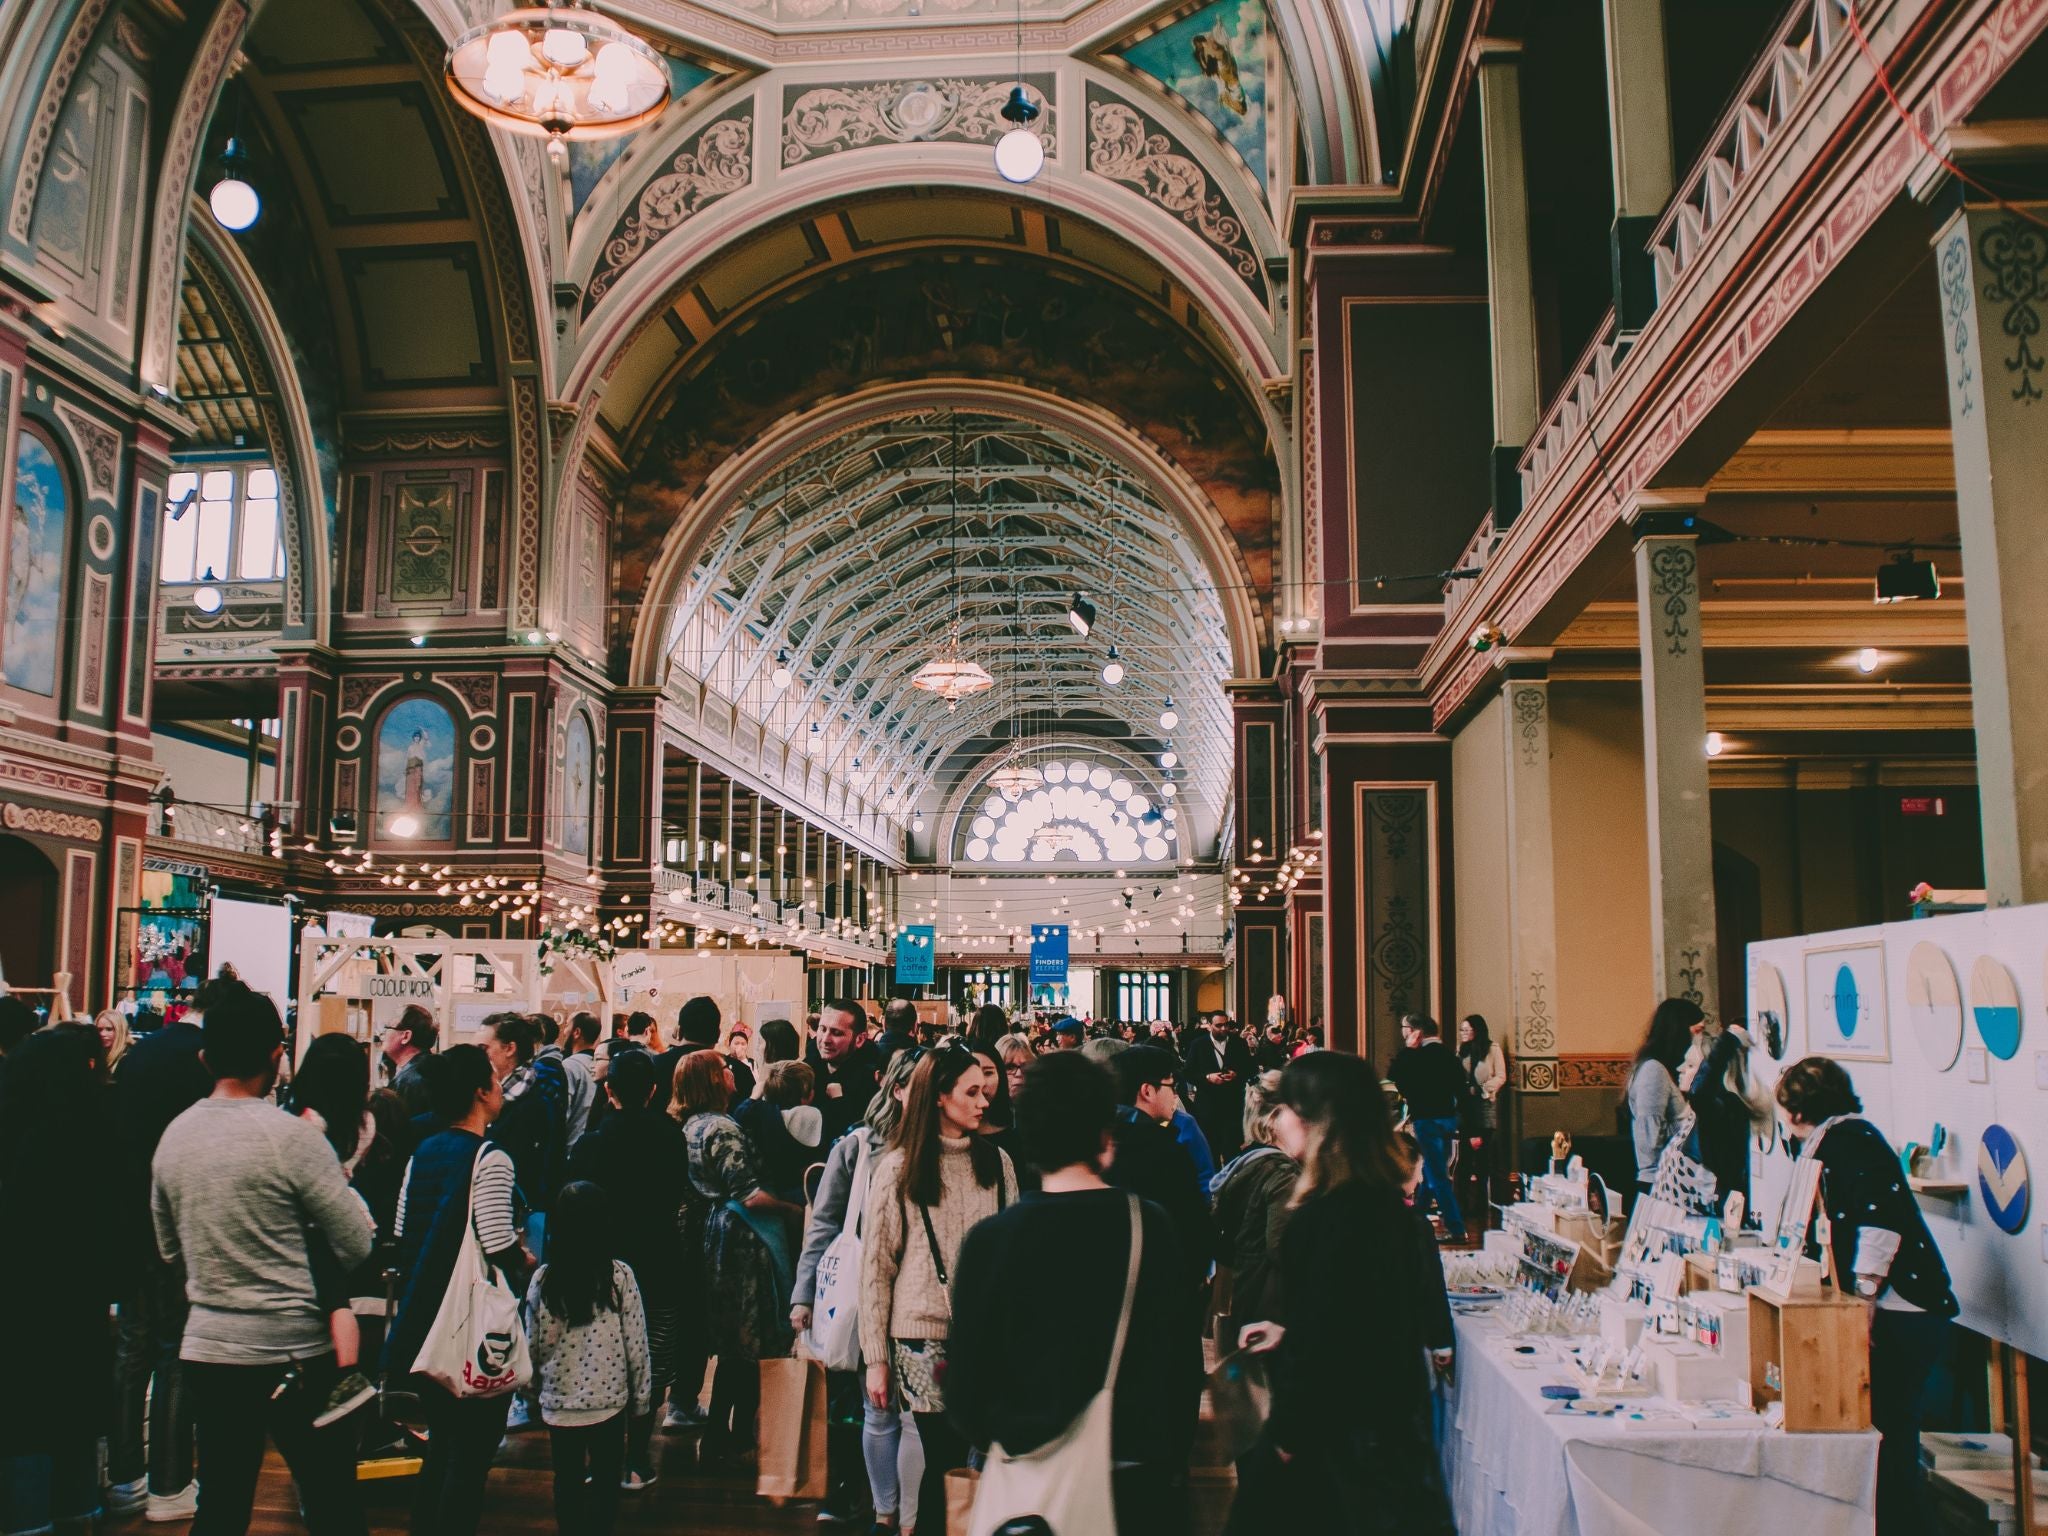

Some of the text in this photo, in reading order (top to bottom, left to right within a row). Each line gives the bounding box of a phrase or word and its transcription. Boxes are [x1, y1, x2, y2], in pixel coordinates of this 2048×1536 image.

[903, 954, 917, 963] bar
[621, 965, 647, 980] frankie
[902, 963, 928, 972] coffee
[369, 978, 434, 998] COLOUR WORK
